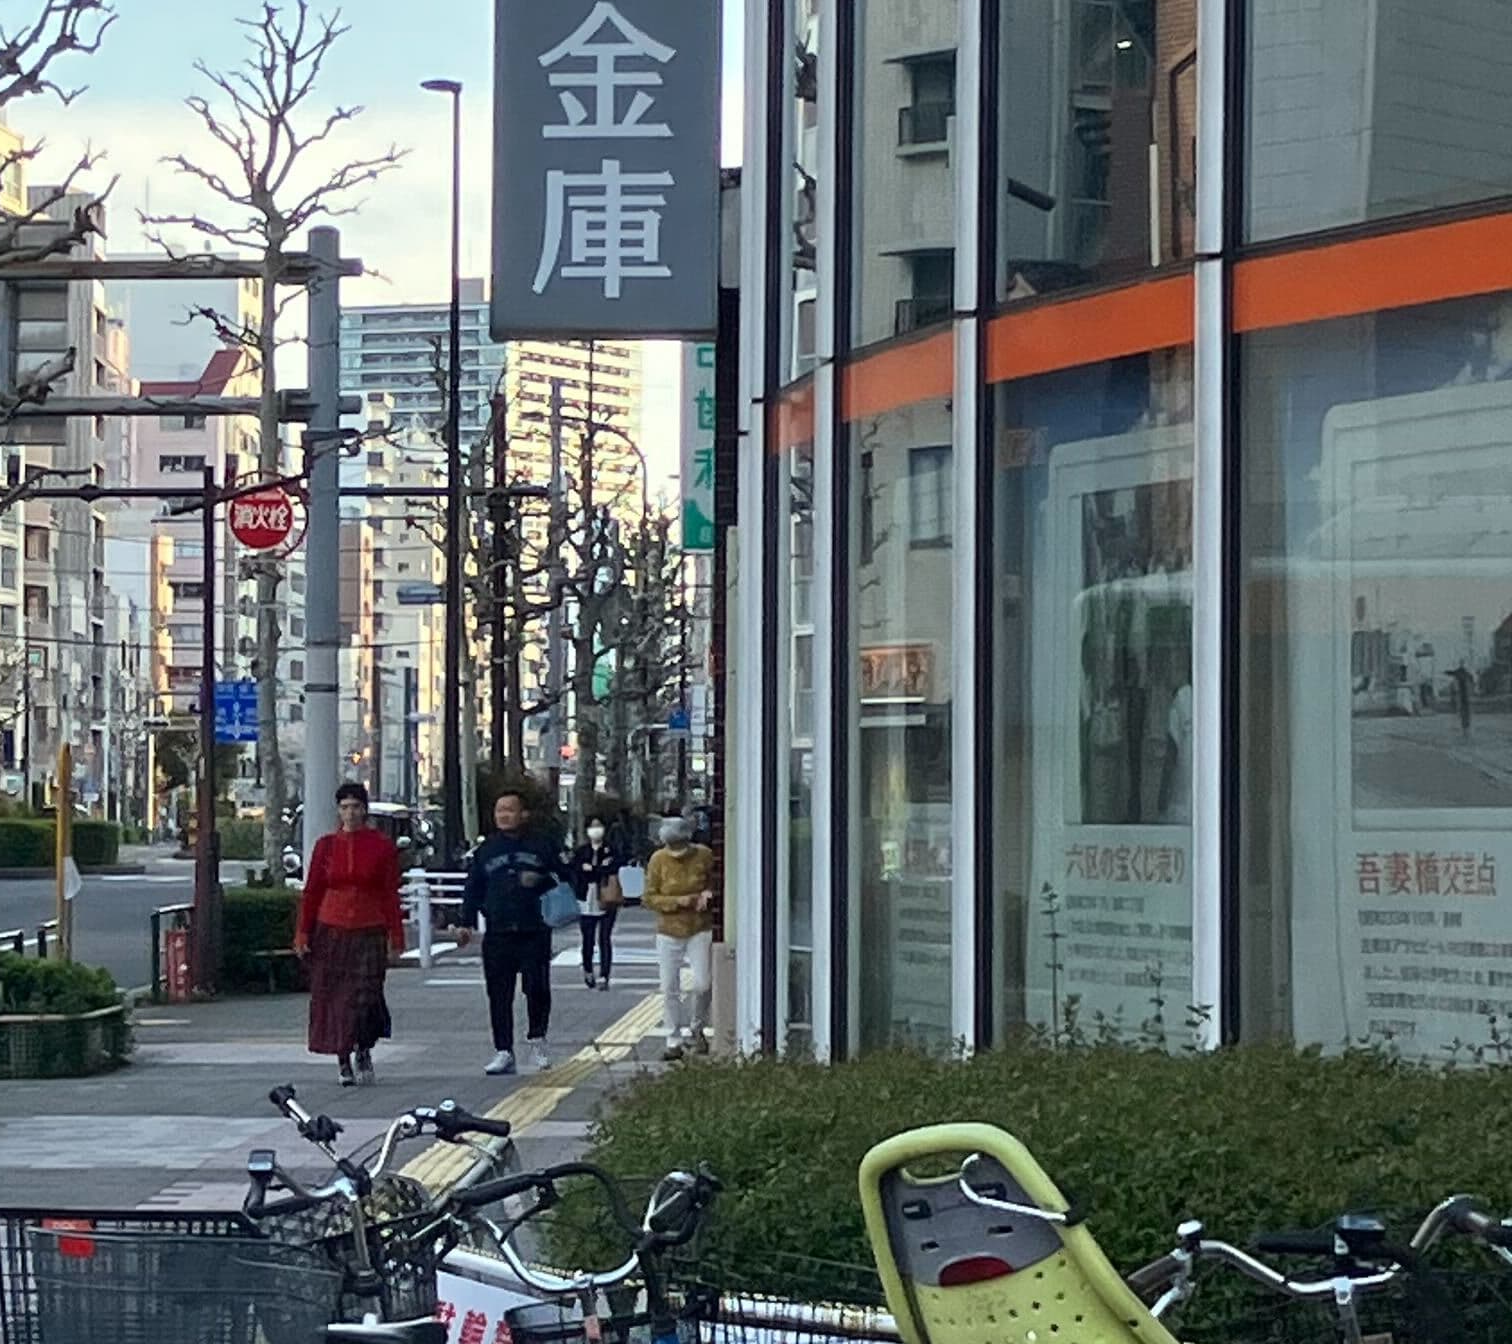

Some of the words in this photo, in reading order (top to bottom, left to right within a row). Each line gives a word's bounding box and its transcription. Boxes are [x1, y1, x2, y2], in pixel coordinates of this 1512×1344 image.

[233, 502, 288, 532] 消火栓
[1356, 851, 1497, 897] 吾妻橋交差点
